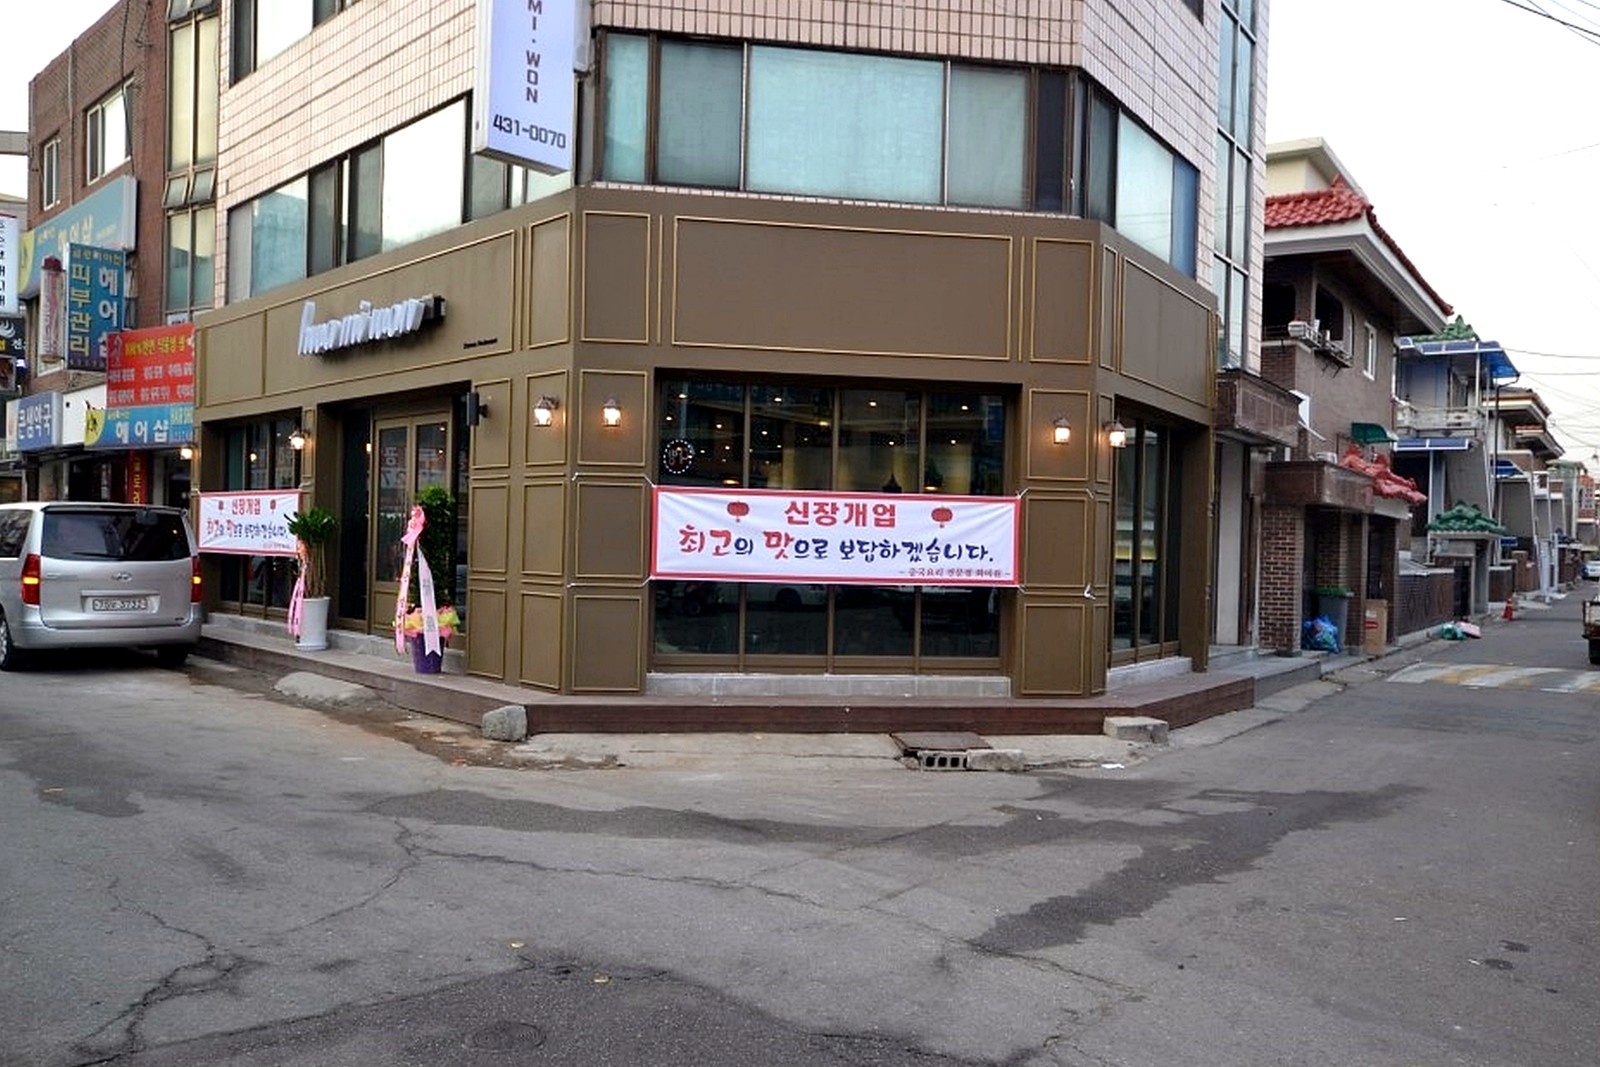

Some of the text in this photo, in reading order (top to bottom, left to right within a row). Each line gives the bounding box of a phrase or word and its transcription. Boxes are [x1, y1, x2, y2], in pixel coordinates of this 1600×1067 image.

[492, 113, 567, 149] 431-0070
[70, 263, 91, 357] 피부관리
[231, 498, 261, 515] 신장개업
[784, 500, 896, 528] 신장개업
[678, 524, 994, 563] 최고의 맛으로 보답하겠습니다.
